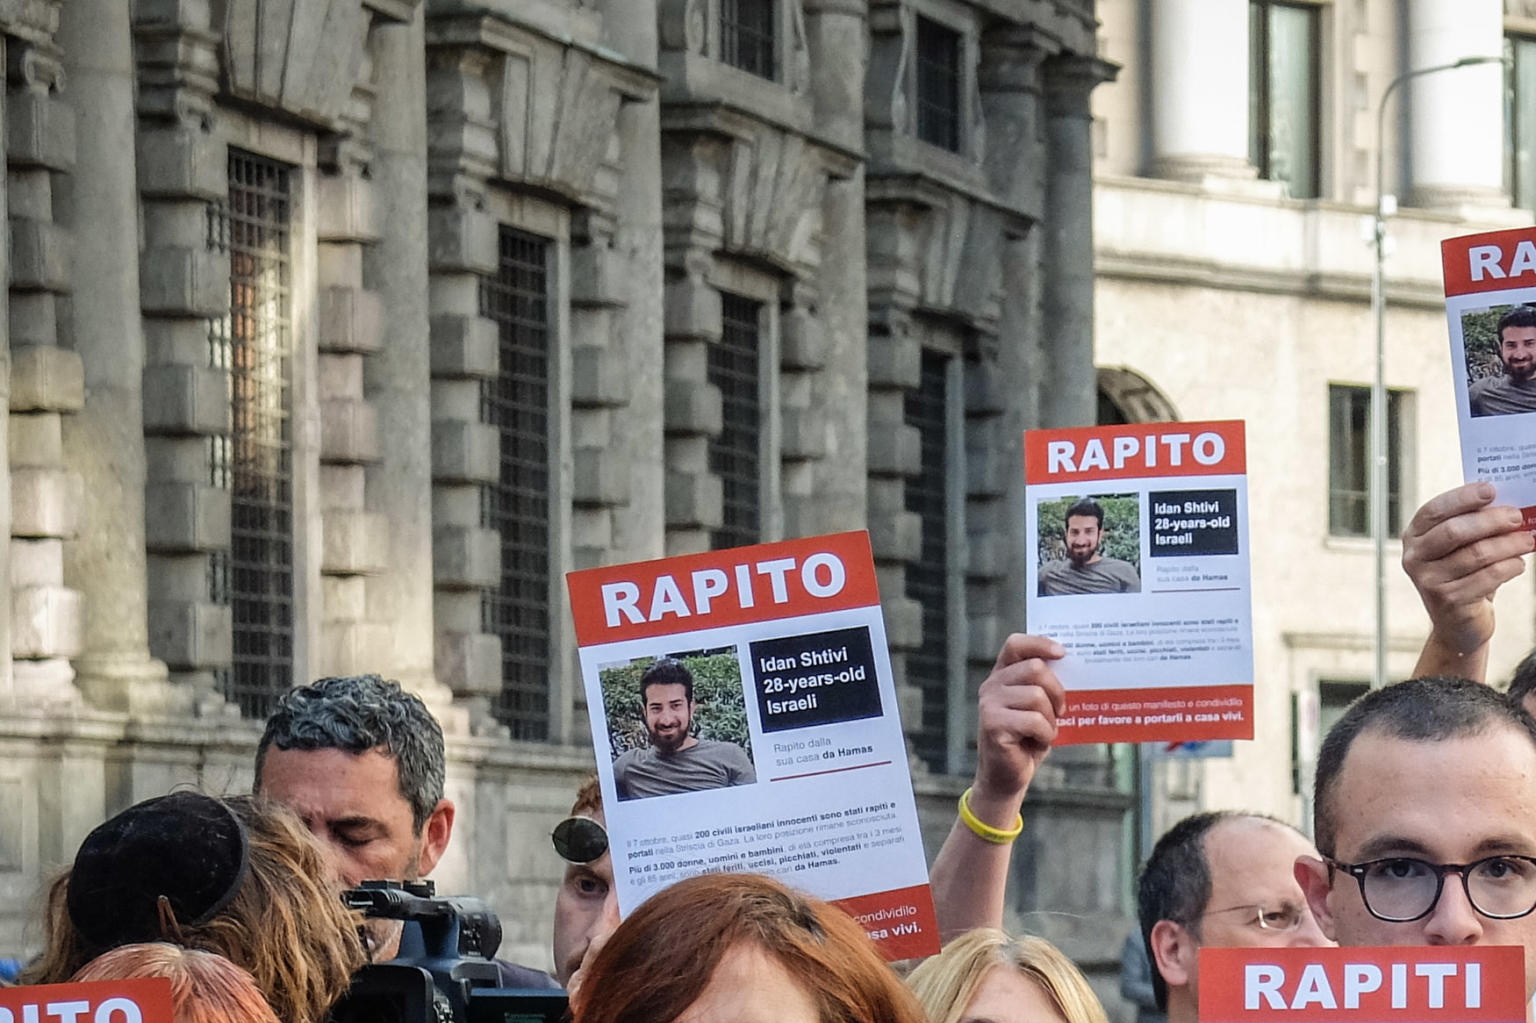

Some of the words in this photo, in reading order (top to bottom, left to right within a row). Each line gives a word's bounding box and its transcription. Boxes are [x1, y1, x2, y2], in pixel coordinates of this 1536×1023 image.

[1047, 432, 1225, 473] RAPITO
[1154, 502, 1181, 515] Idan
[1183, 500, 1219, 514] Shtivi
[1154, 515, 1230, 532] 28-years-old
[1155, 532, 1192, 545] Israeli
[601, 552, 846, 627] RAPITO
[760, 656, 796, 672] Idan
[800, 646, 848, 667] Shtivi
[763, 665, 865, 694] 28-years-old
[766, 693, 817, 715] Israeli
[1244, 962, 1481, 1010] RAPITI
